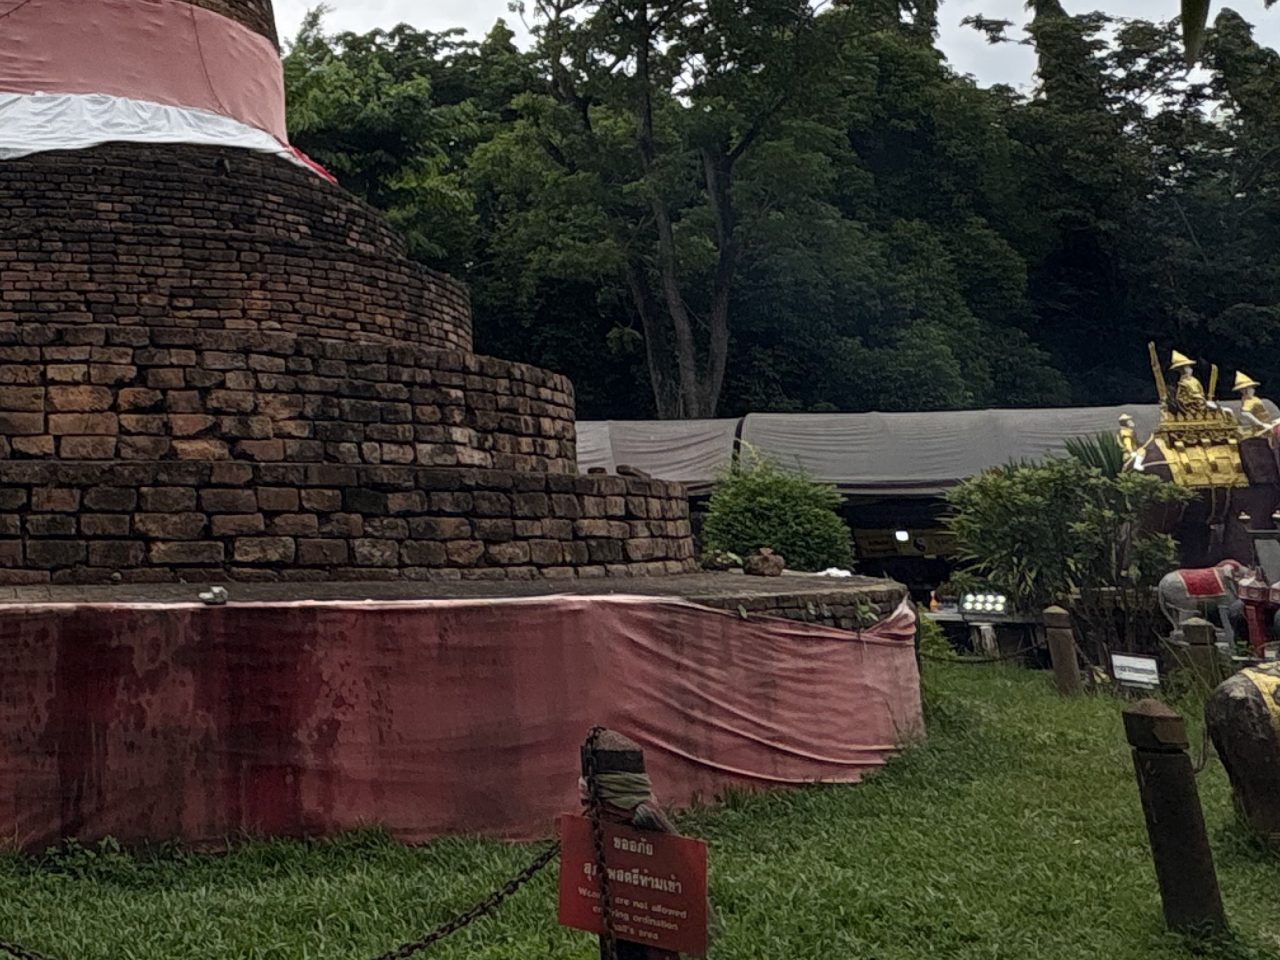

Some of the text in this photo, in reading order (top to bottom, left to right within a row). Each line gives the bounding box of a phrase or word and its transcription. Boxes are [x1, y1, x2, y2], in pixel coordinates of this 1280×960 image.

[613, 837, 654, 856] ขออภัย
[583, 862, 682, 894] สุพสตรีห้ามเข้า
[593, 905, 679, 931] enring ordination
[615, 896, 630, 906] are
[633, 900, 648, 910] not
[651, 904, 687, 919] allowed
[638, 929, 658, 940] area
